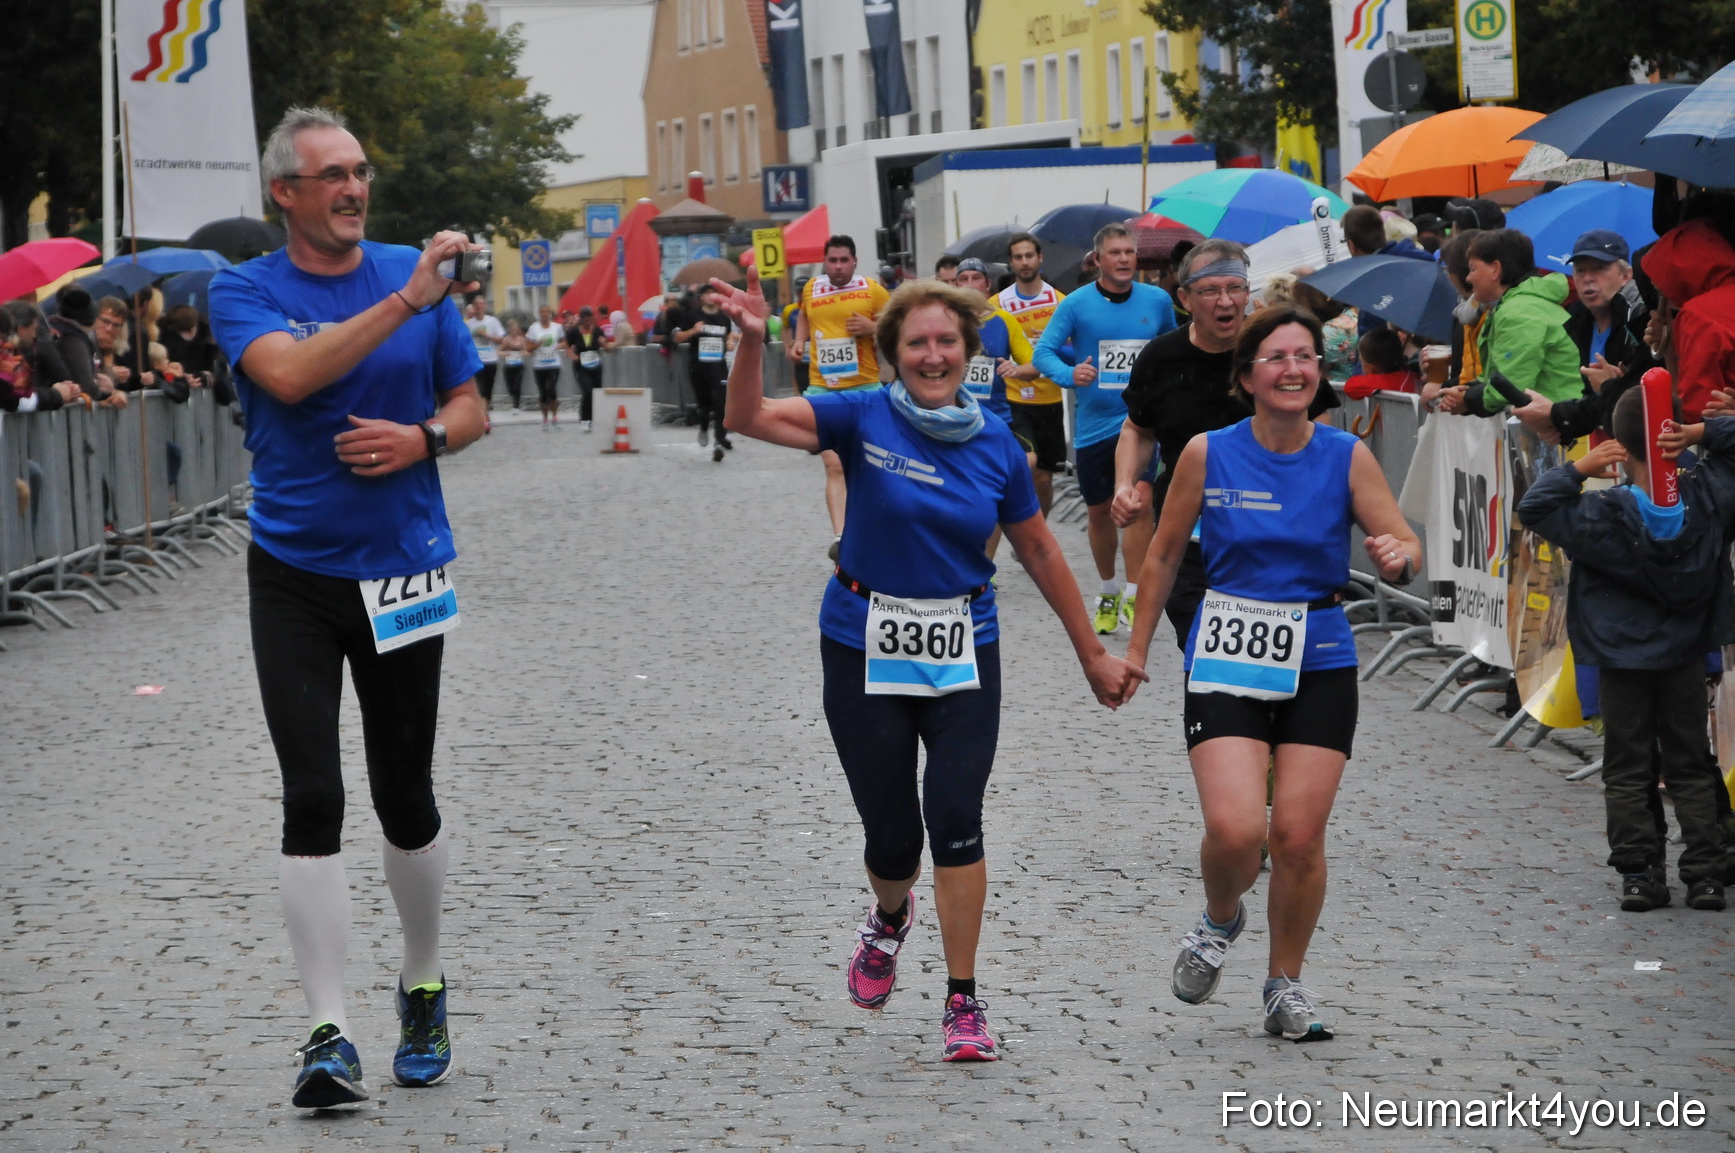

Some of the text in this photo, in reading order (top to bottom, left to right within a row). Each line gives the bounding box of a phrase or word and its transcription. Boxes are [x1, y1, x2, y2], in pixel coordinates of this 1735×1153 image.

[1475, 7, 1495, 31] H
[1425, 32, 1449, 42] Gasse
[134, 158, 202, 169] stadtwerke
[768, 170, 804, 202] KL
[756, 230, 781, 240] Block
[763, 243, 779, 267] D
[525, 272, 549, 282] TAXI
[811, 296, 836, 308] MAX
[820, 347, 853, 363] 2545
[1665, 469, 1677, 503] BKK
[872, 602, 959, 617] PARTL Neumarkt
[1205, 600, 1287, 619] PARTL Neumarkt
[878, 618, 965, 660] 3360
[1205, 615, 1294, 663] 3389
